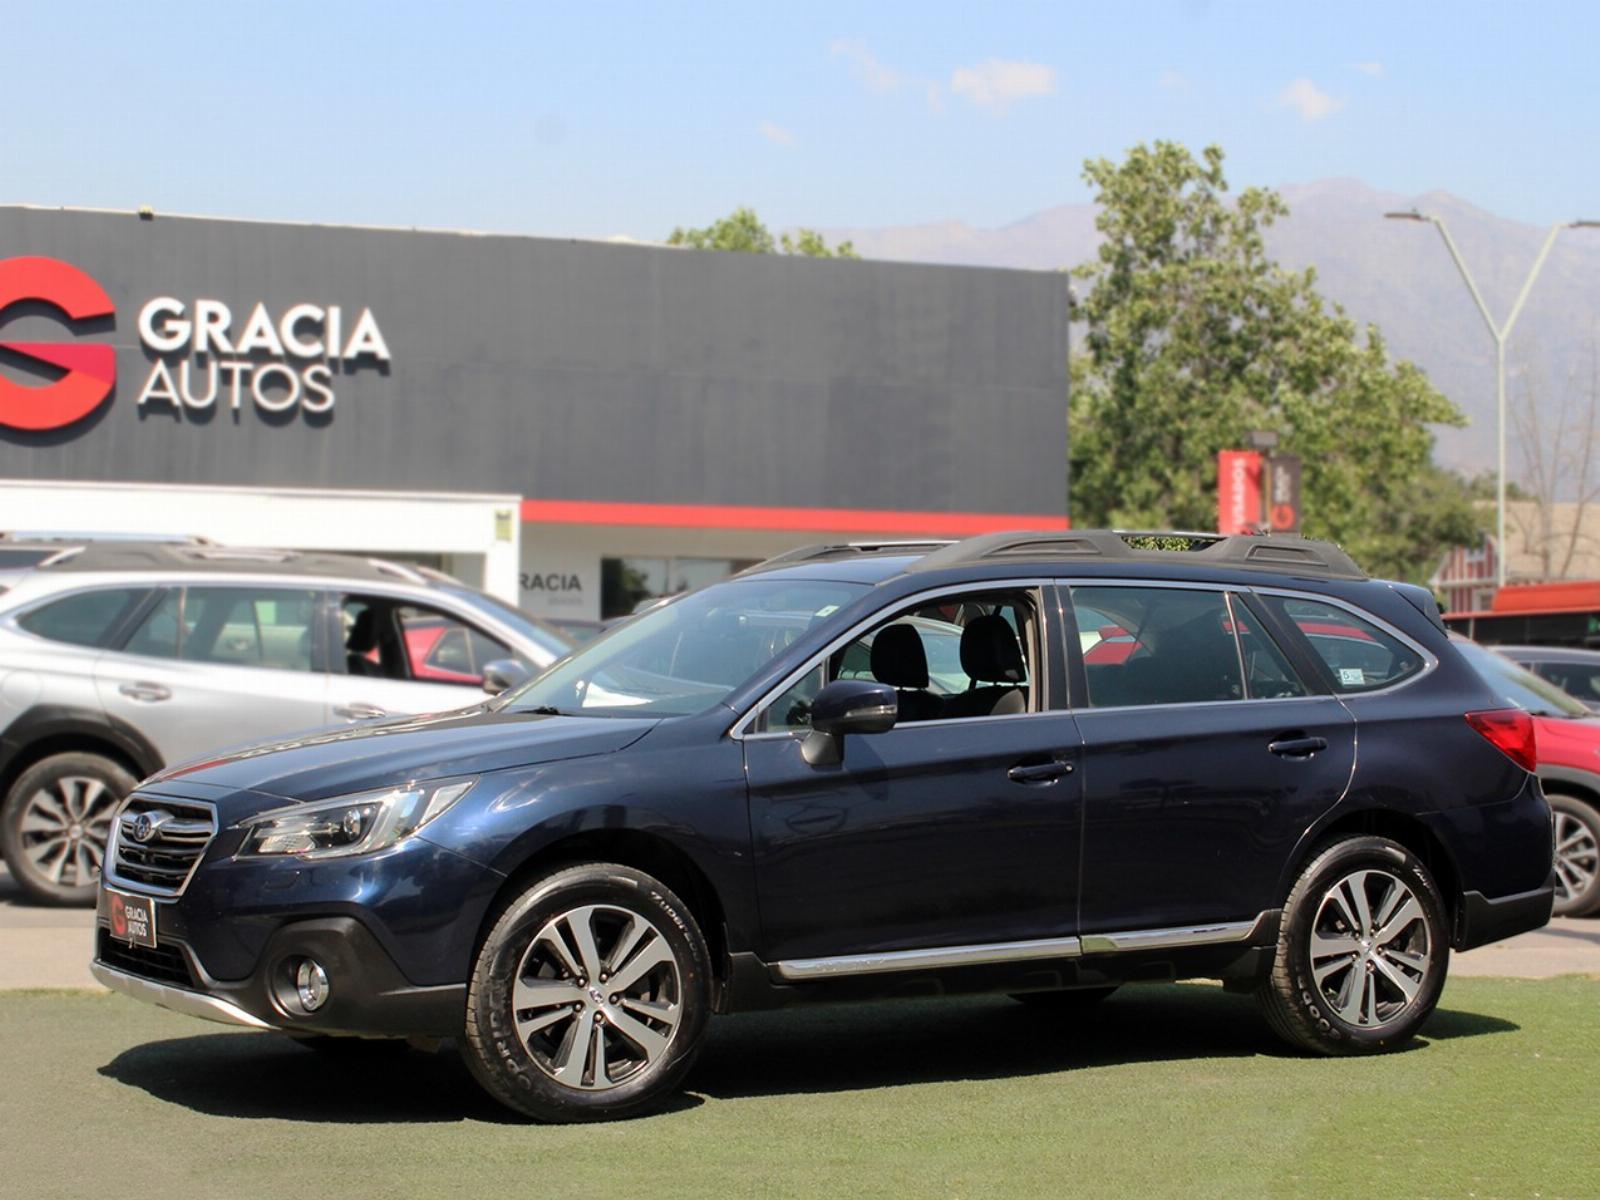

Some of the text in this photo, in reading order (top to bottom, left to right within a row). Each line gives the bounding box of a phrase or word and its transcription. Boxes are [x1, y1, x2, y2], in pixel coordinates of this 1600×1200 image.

[137, 296, 391, 360] GRACIA
[137, 358, 335, 412] AUTOS
[519, 573, 583, 592] RACIA
[124, 905, 149, 923] GRACIA
[127, 920, 148, 937] AUTOS
